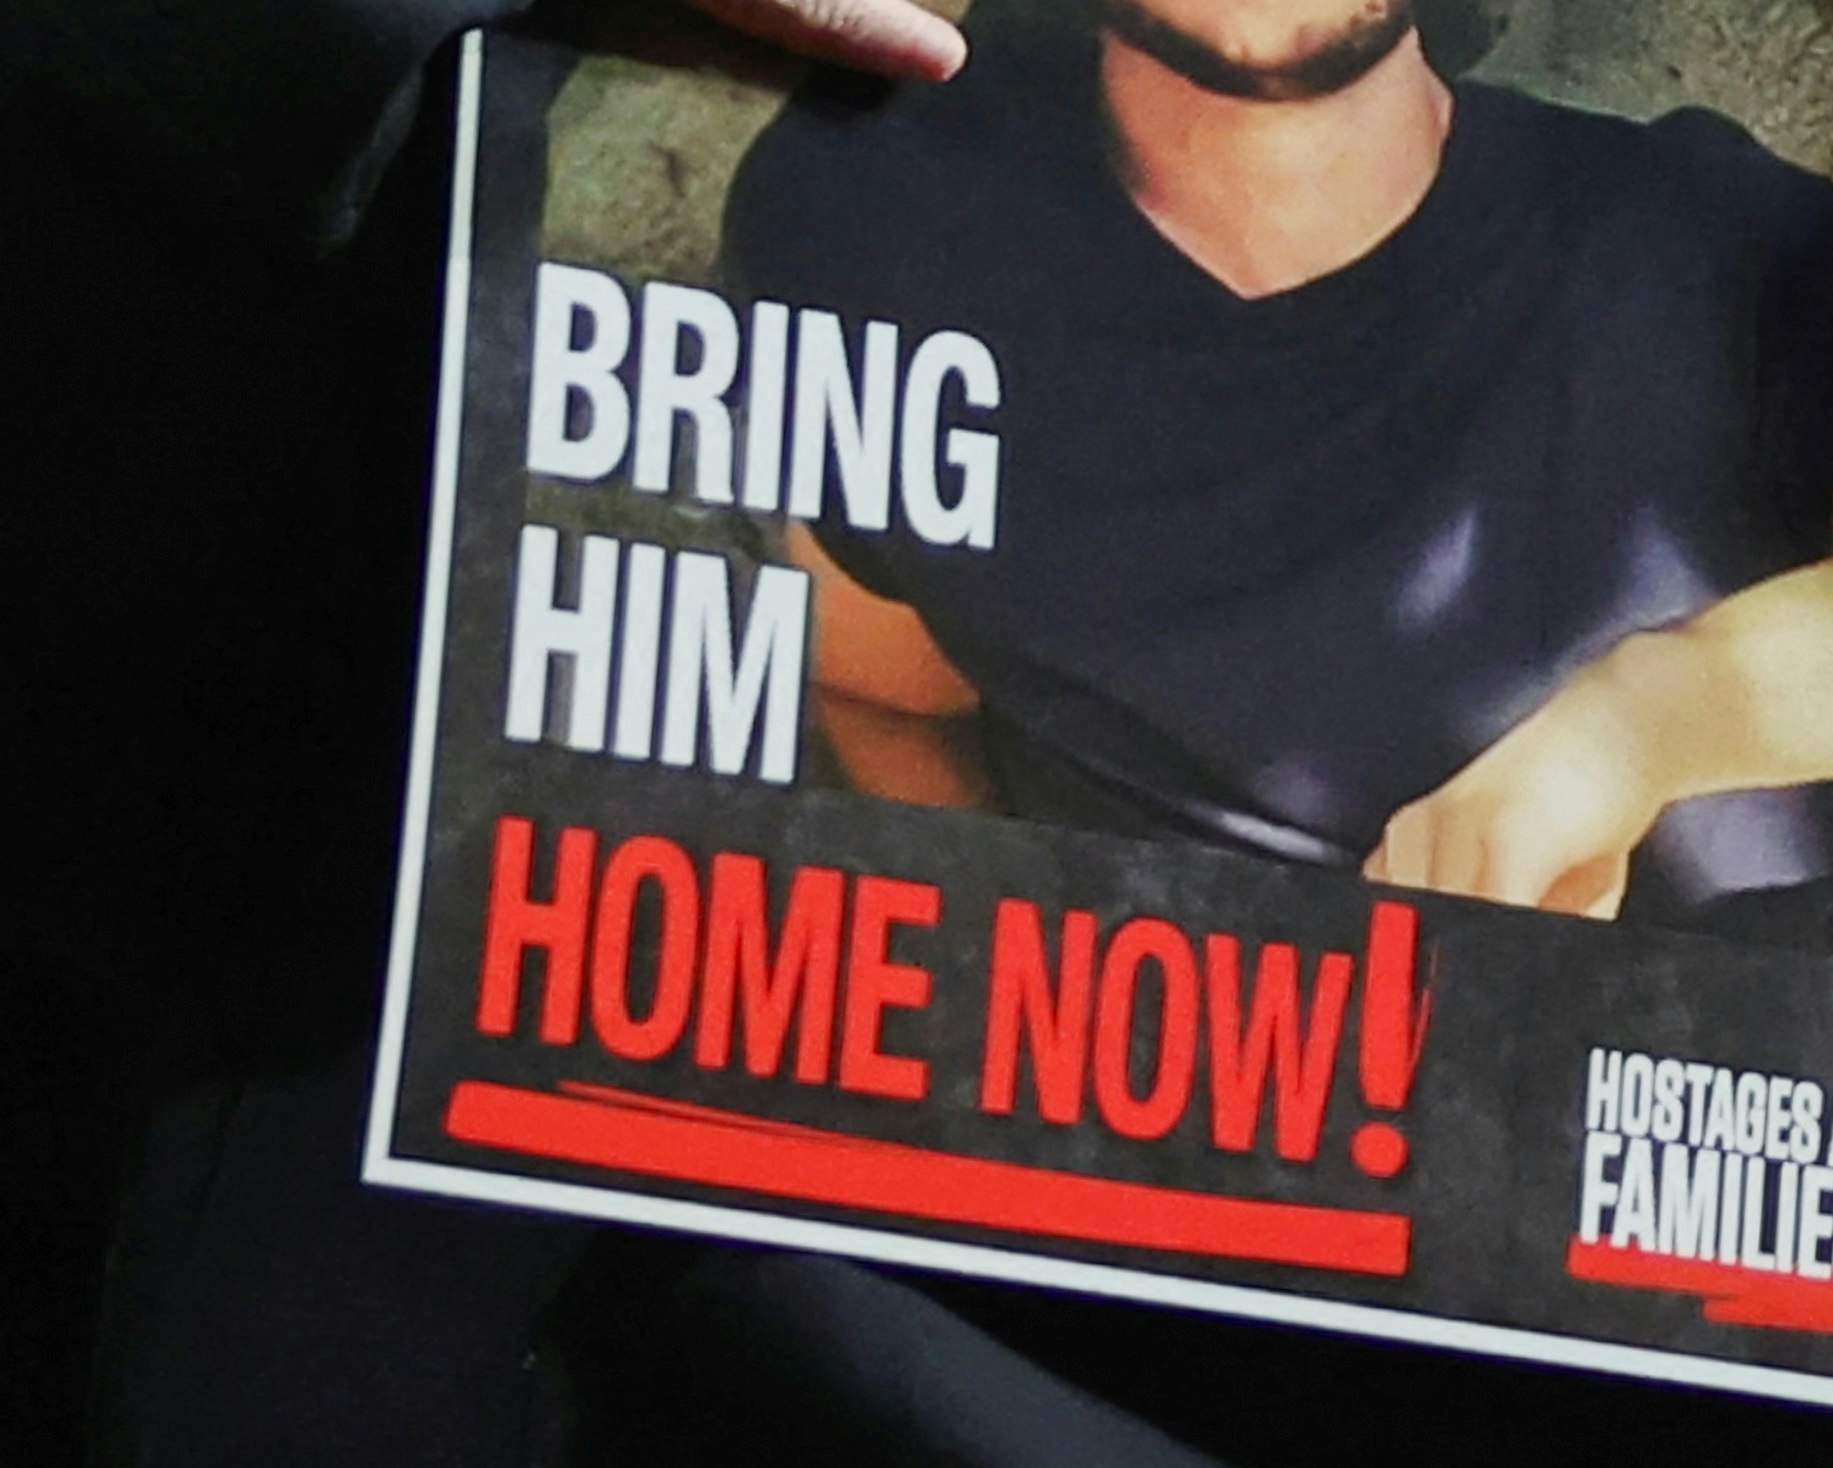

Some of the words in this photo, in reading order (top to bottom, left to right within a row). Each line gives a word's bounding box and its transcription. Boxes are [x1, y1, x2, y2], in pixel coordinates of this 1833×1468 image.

[528, 263, 1000, 550] BRING
[505, 524, 809, 784] HIM
[476, 814, 940, 1099] HOME
[980, 900, 1430, 1177] NOW!
[1587, 1048, 1823, 1163] HOSTAGES
